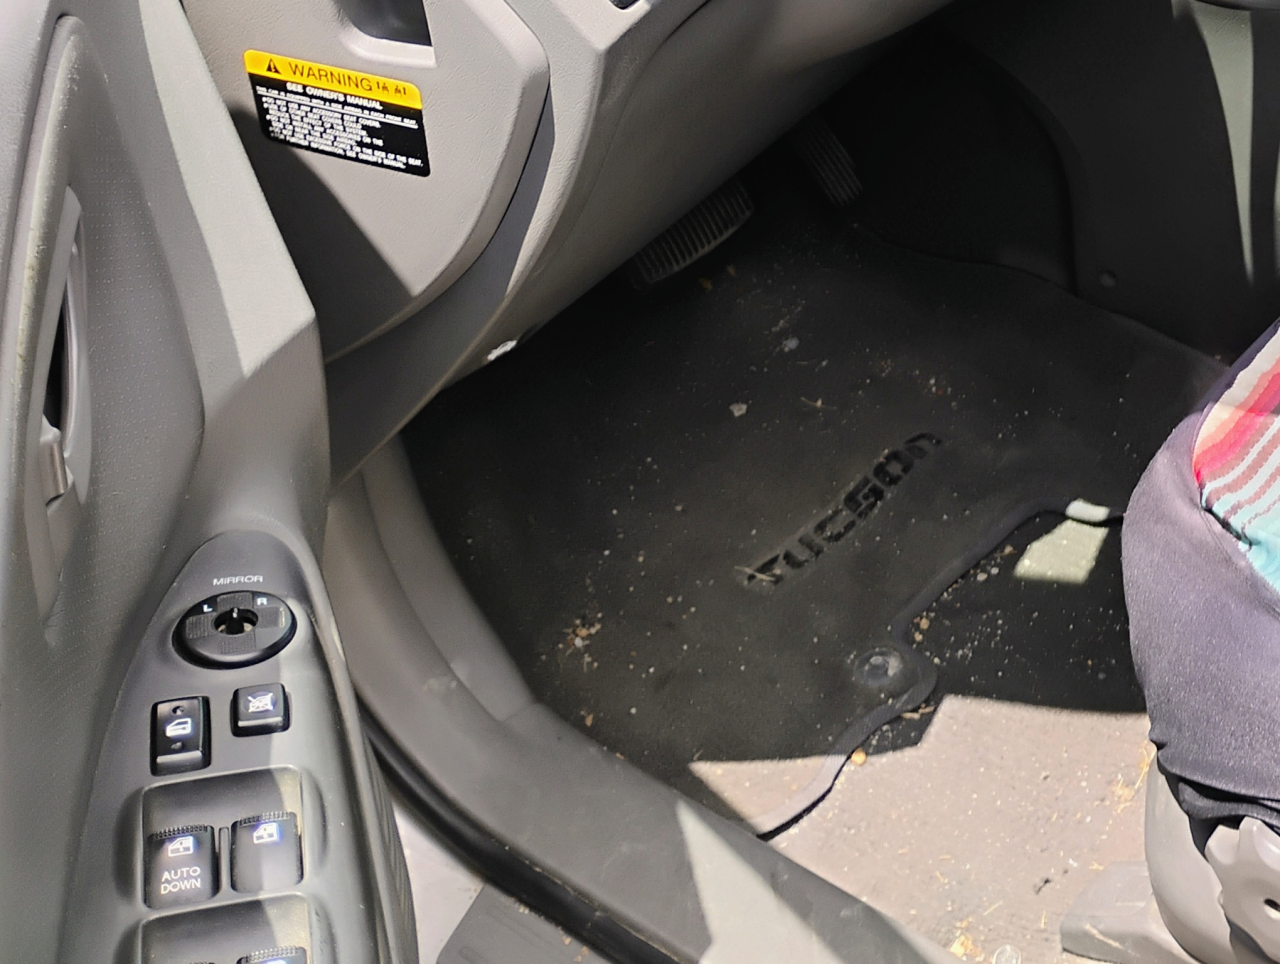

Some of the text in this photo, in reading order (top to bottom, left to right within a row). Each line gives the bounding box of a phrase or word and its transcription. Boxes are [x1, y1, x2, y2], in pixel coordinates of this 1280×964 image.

[288, 62, 373, 92] WARNING
[286, 82, 304, 93] SEE
[305, 86, 344, 102] OWNER'S
[213, 575, 264, 586] MIRROR
[203, 597, 268, 612] L R
[161, 866, 201, 882] AUTO
[160, 878, 201, 894] DOWN
